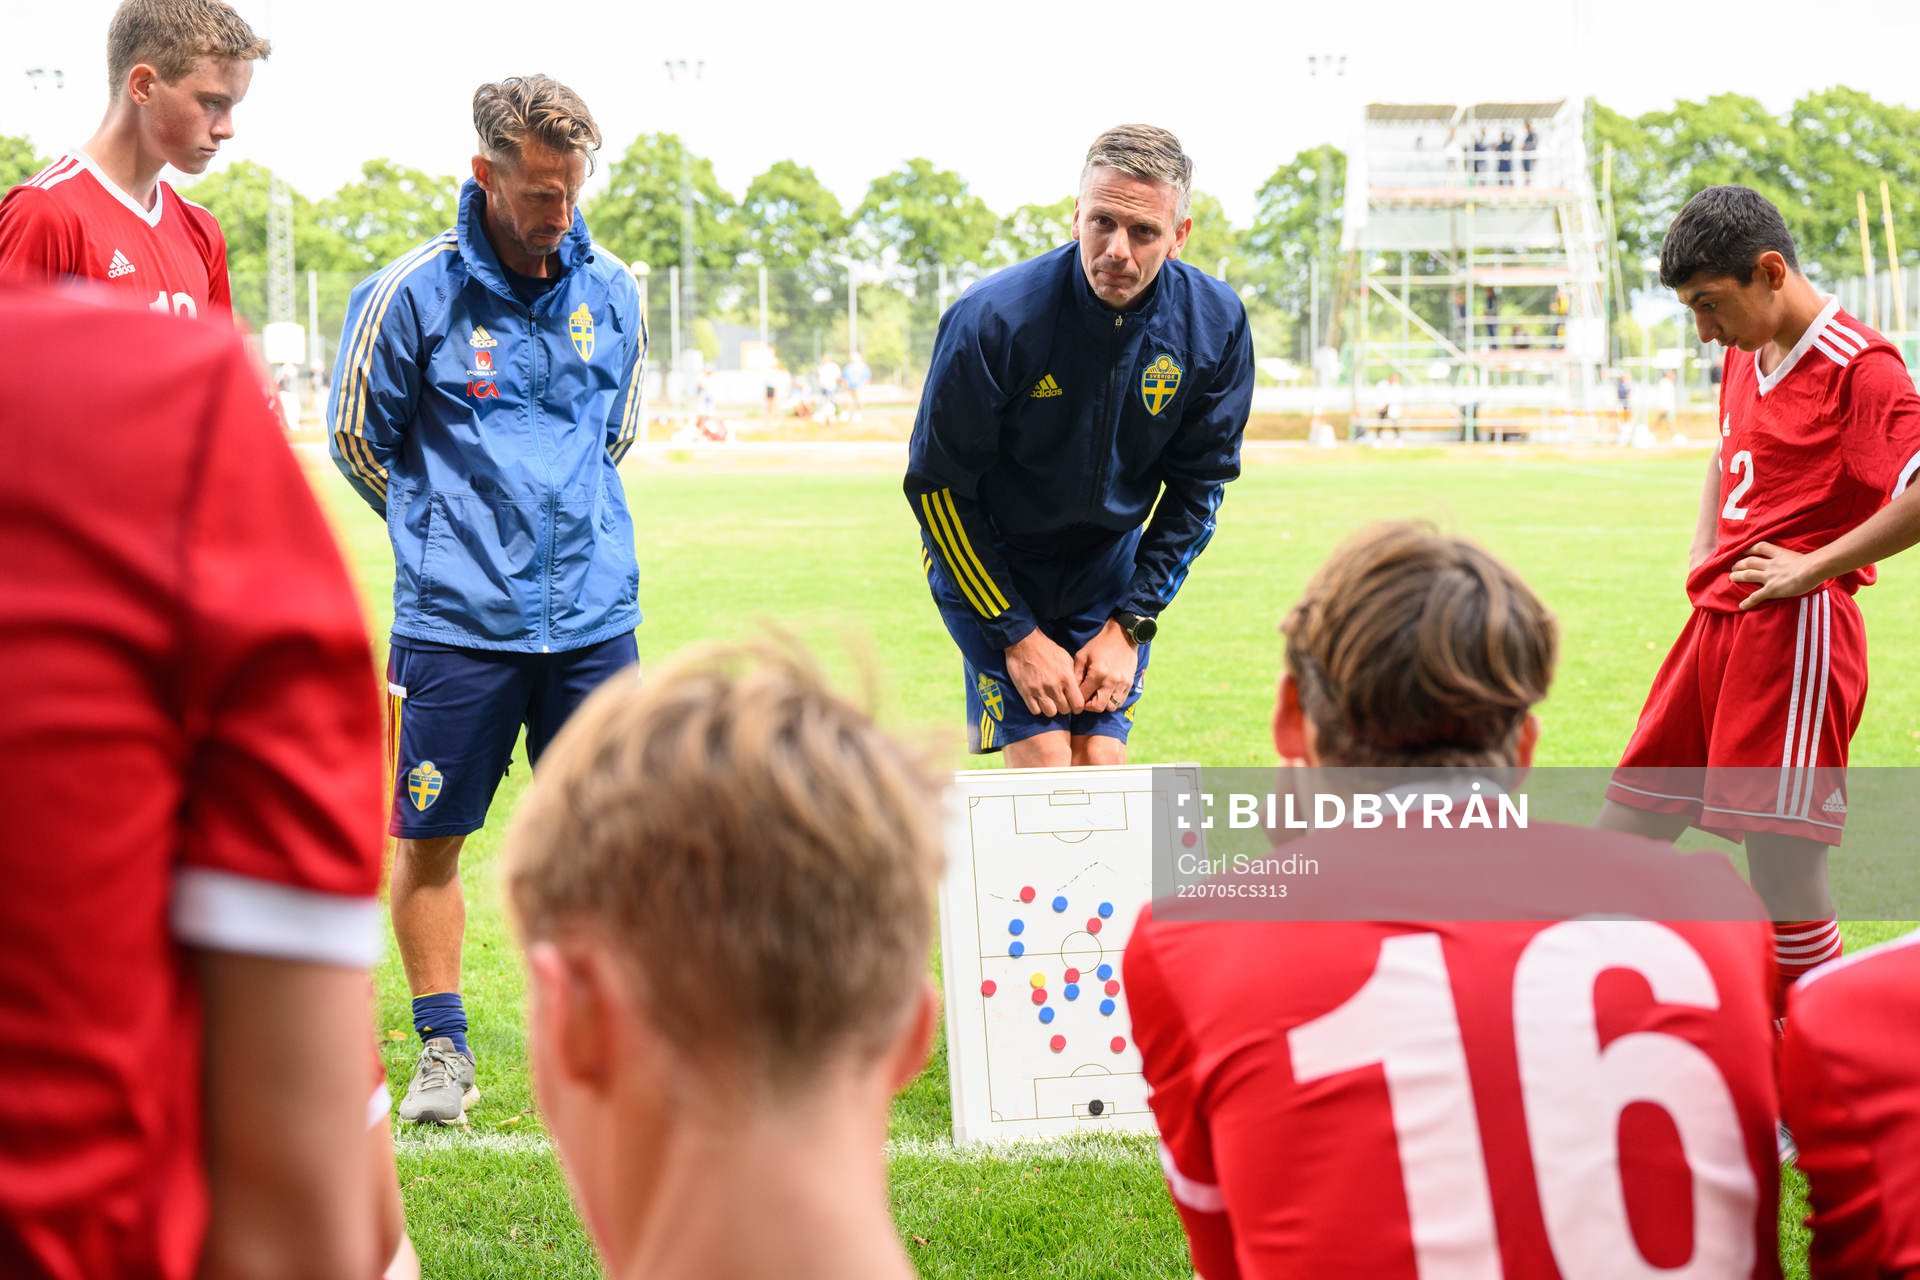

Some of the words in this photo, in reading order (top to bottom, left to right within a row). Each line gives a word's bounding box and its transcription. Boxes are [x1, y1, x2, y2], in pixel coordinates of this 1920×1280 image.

[107, 264, 136, 279] adidas
[466, 379, 500, 399] ICA
[1030, 388, 1063, 398] adidas
[1719, 437, 1754, 520] 2
[1287, 914, 1760, 1280] 16
